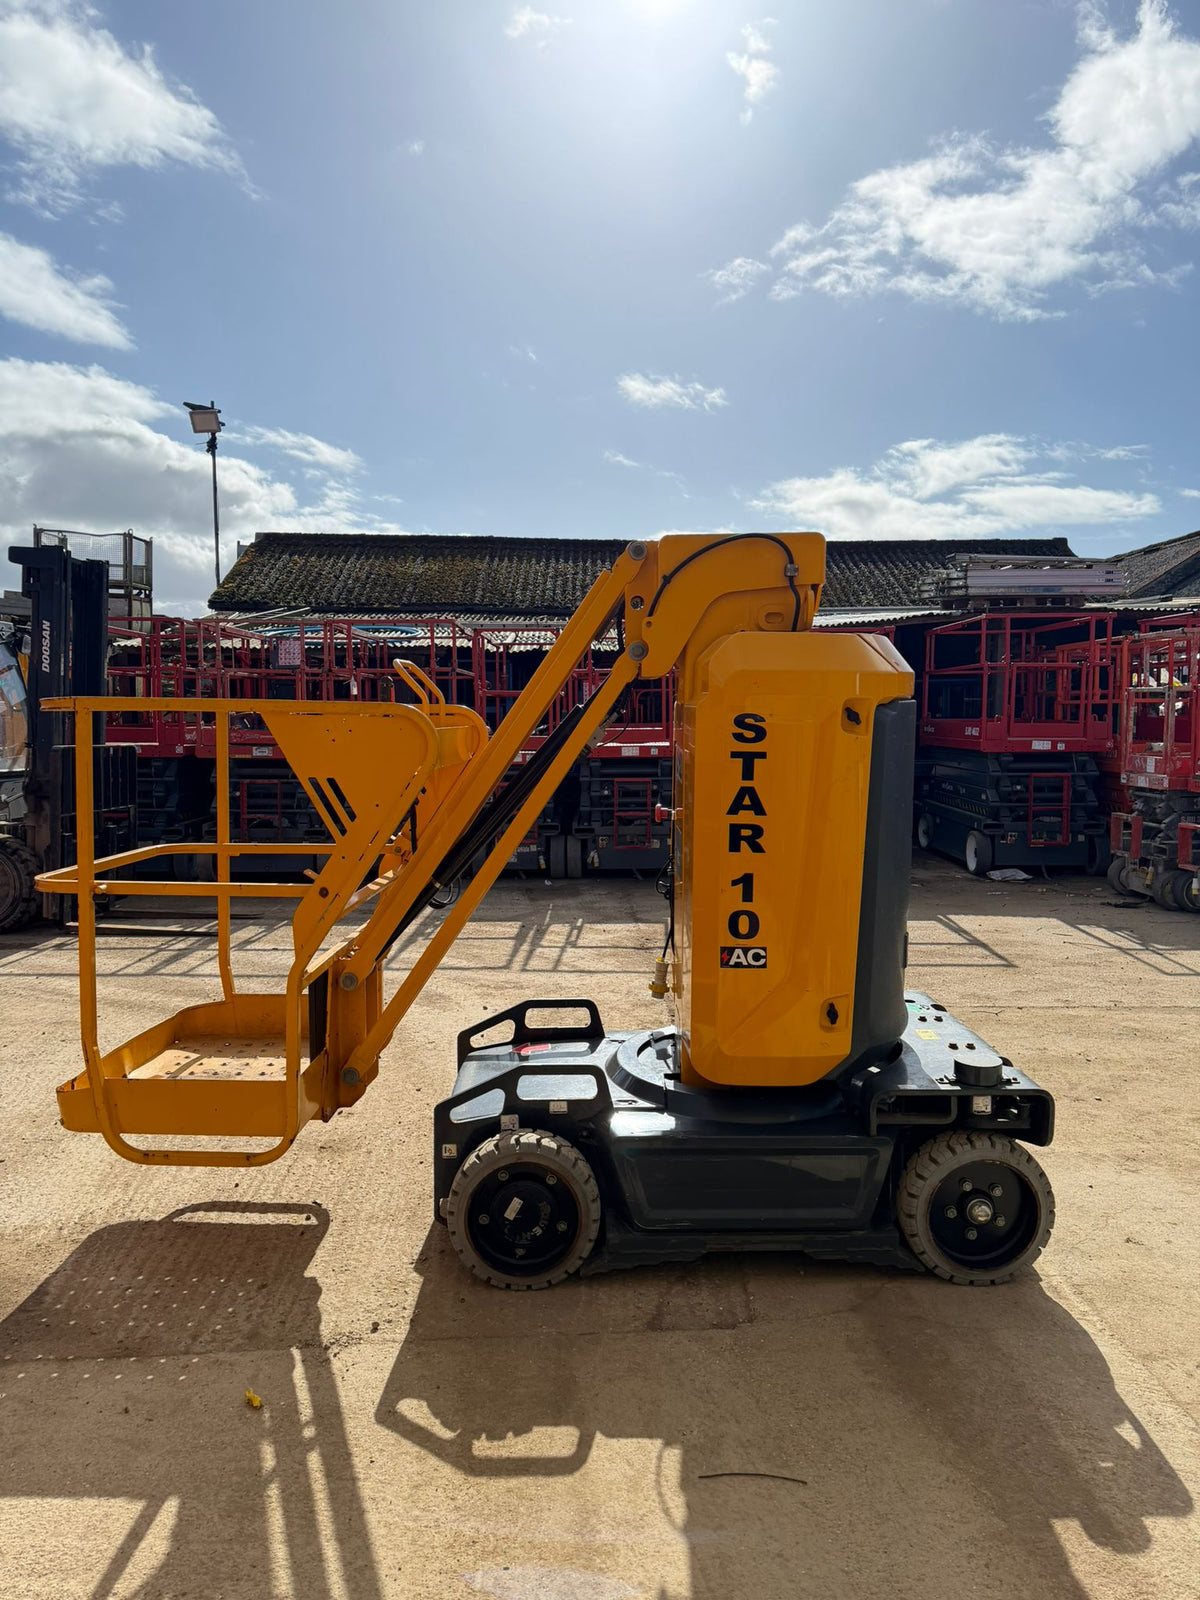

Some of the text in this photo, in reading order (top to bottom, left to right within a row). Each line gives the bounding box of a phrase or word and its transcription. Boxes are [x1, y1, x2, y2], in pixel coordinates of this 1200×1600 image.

[42, 620, 50, 673] DOOSAN
[726, 713, 768, 940] STAR 10
[728, 948, 767, 966] AC
